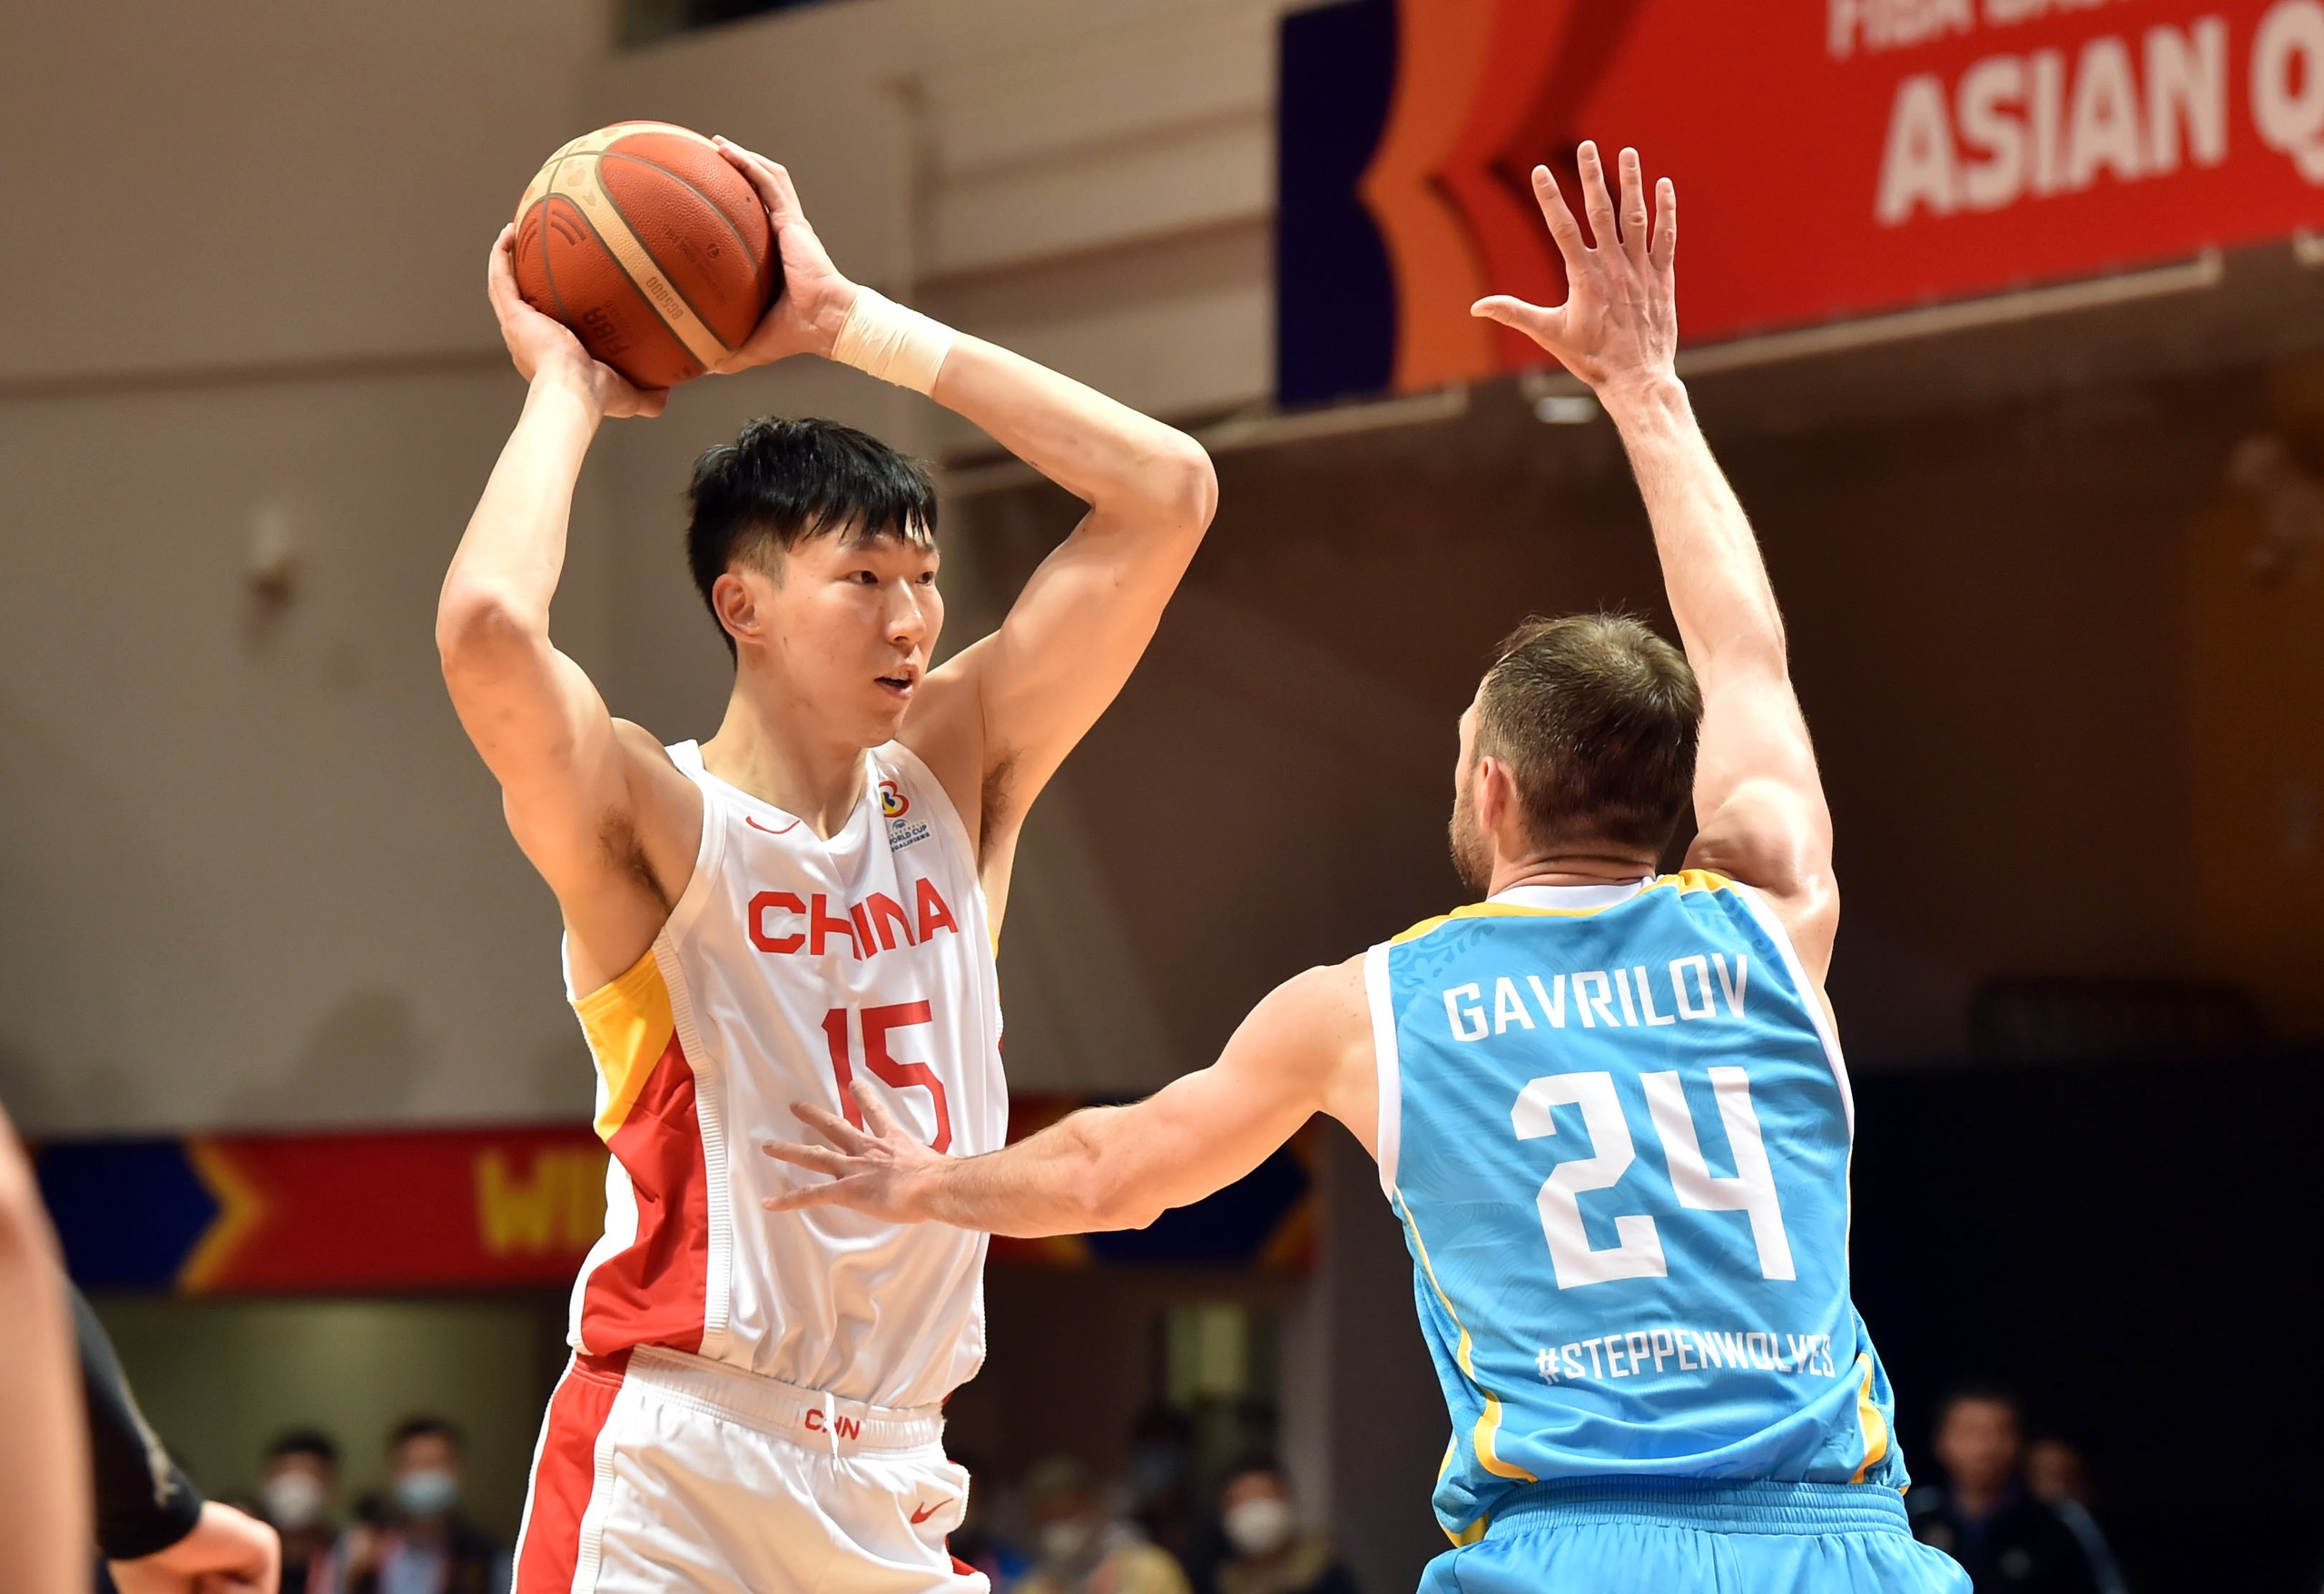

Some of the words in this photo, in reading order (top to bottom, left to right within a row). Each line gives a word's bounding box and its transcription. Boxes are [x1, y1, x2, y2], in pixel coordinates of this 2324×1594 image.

[1873, 15, 2230, 228] ASIAN
[911, 824, 928, 835] CUP
[748, 877, 959, 961] CHINA
[1442, 952, 1748, 1042] GAVRILOV
[821, 999, 952, 1156] 15
[1510, 1066, 1797, 1291] 24
[1535, 1329, 1837, 1385] #STEPPENWOLVES
